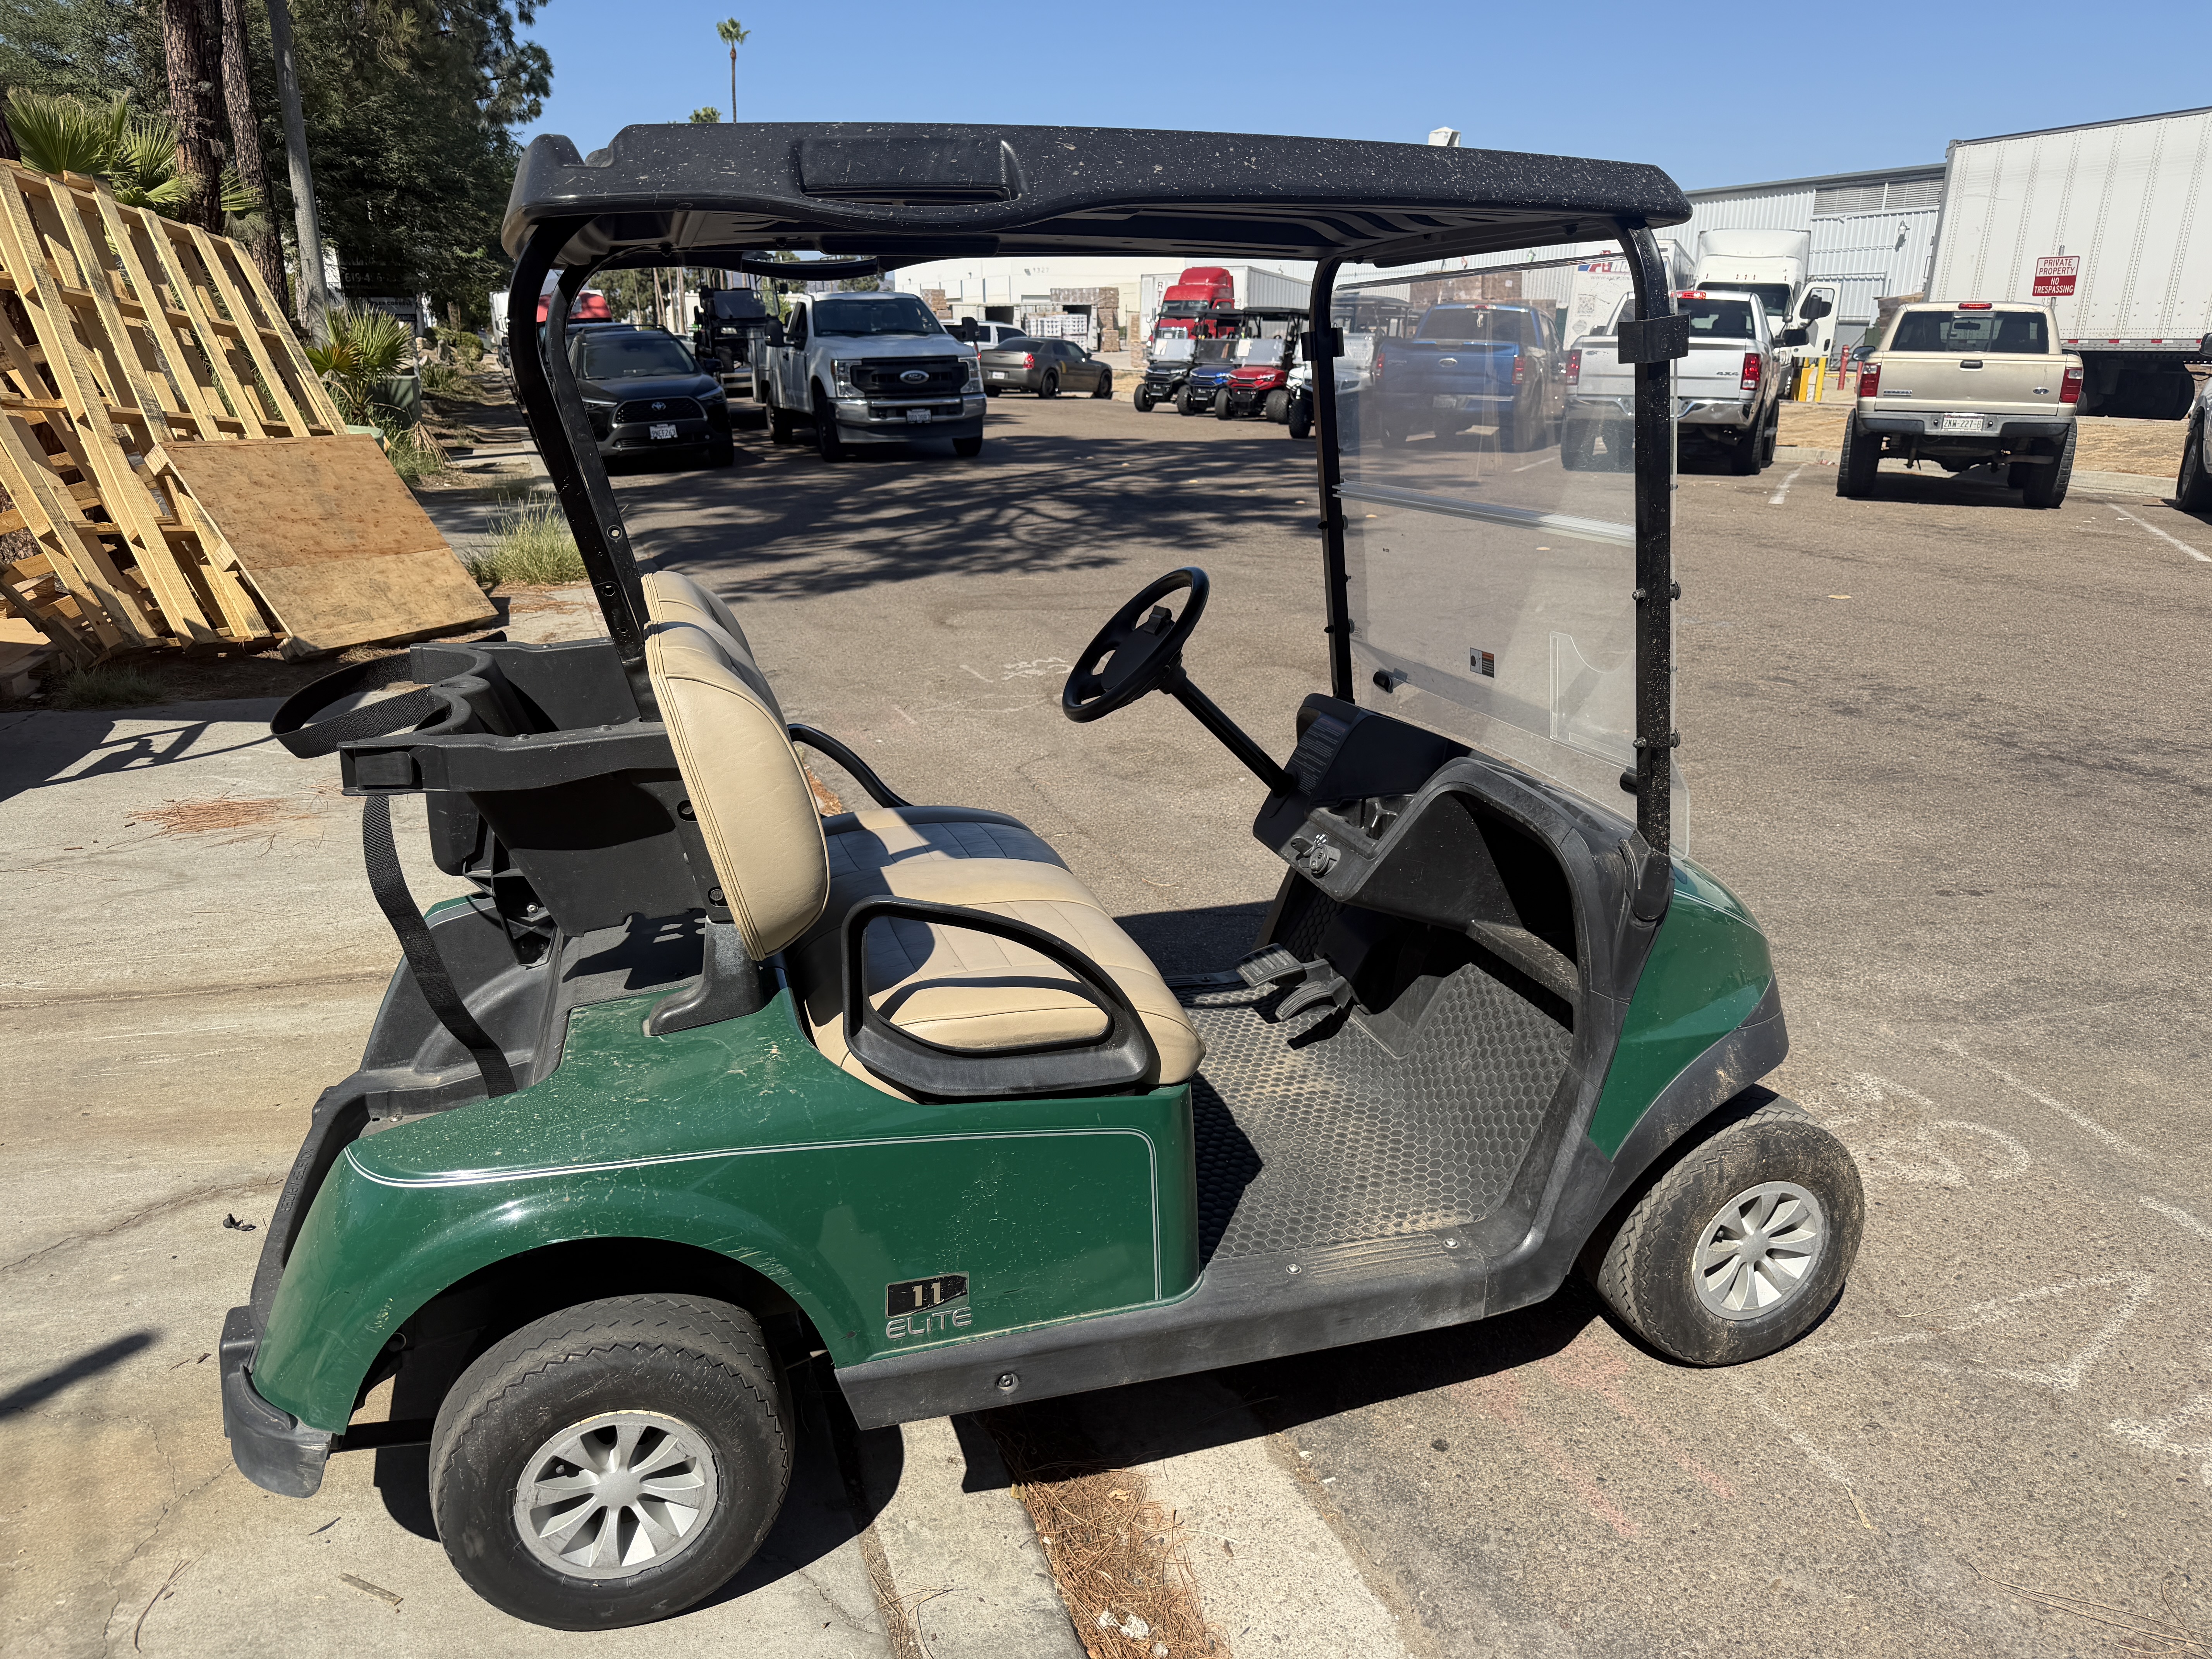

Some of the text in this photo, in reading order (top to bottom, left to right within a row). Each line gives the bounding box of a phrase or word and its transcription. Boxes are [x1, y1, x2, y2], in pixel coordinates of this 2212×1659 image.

[2039, 266, 2075, 275] PROPERTY
[2035, 285, 2073, 294] TRESPASSING
[293, 1162, 309, 1180] STEP
[278, 1187, 299, 1214] RIDER
[912, 1282, 941, 1307] 11
[886, 1307, 972, 1339] ELITE
